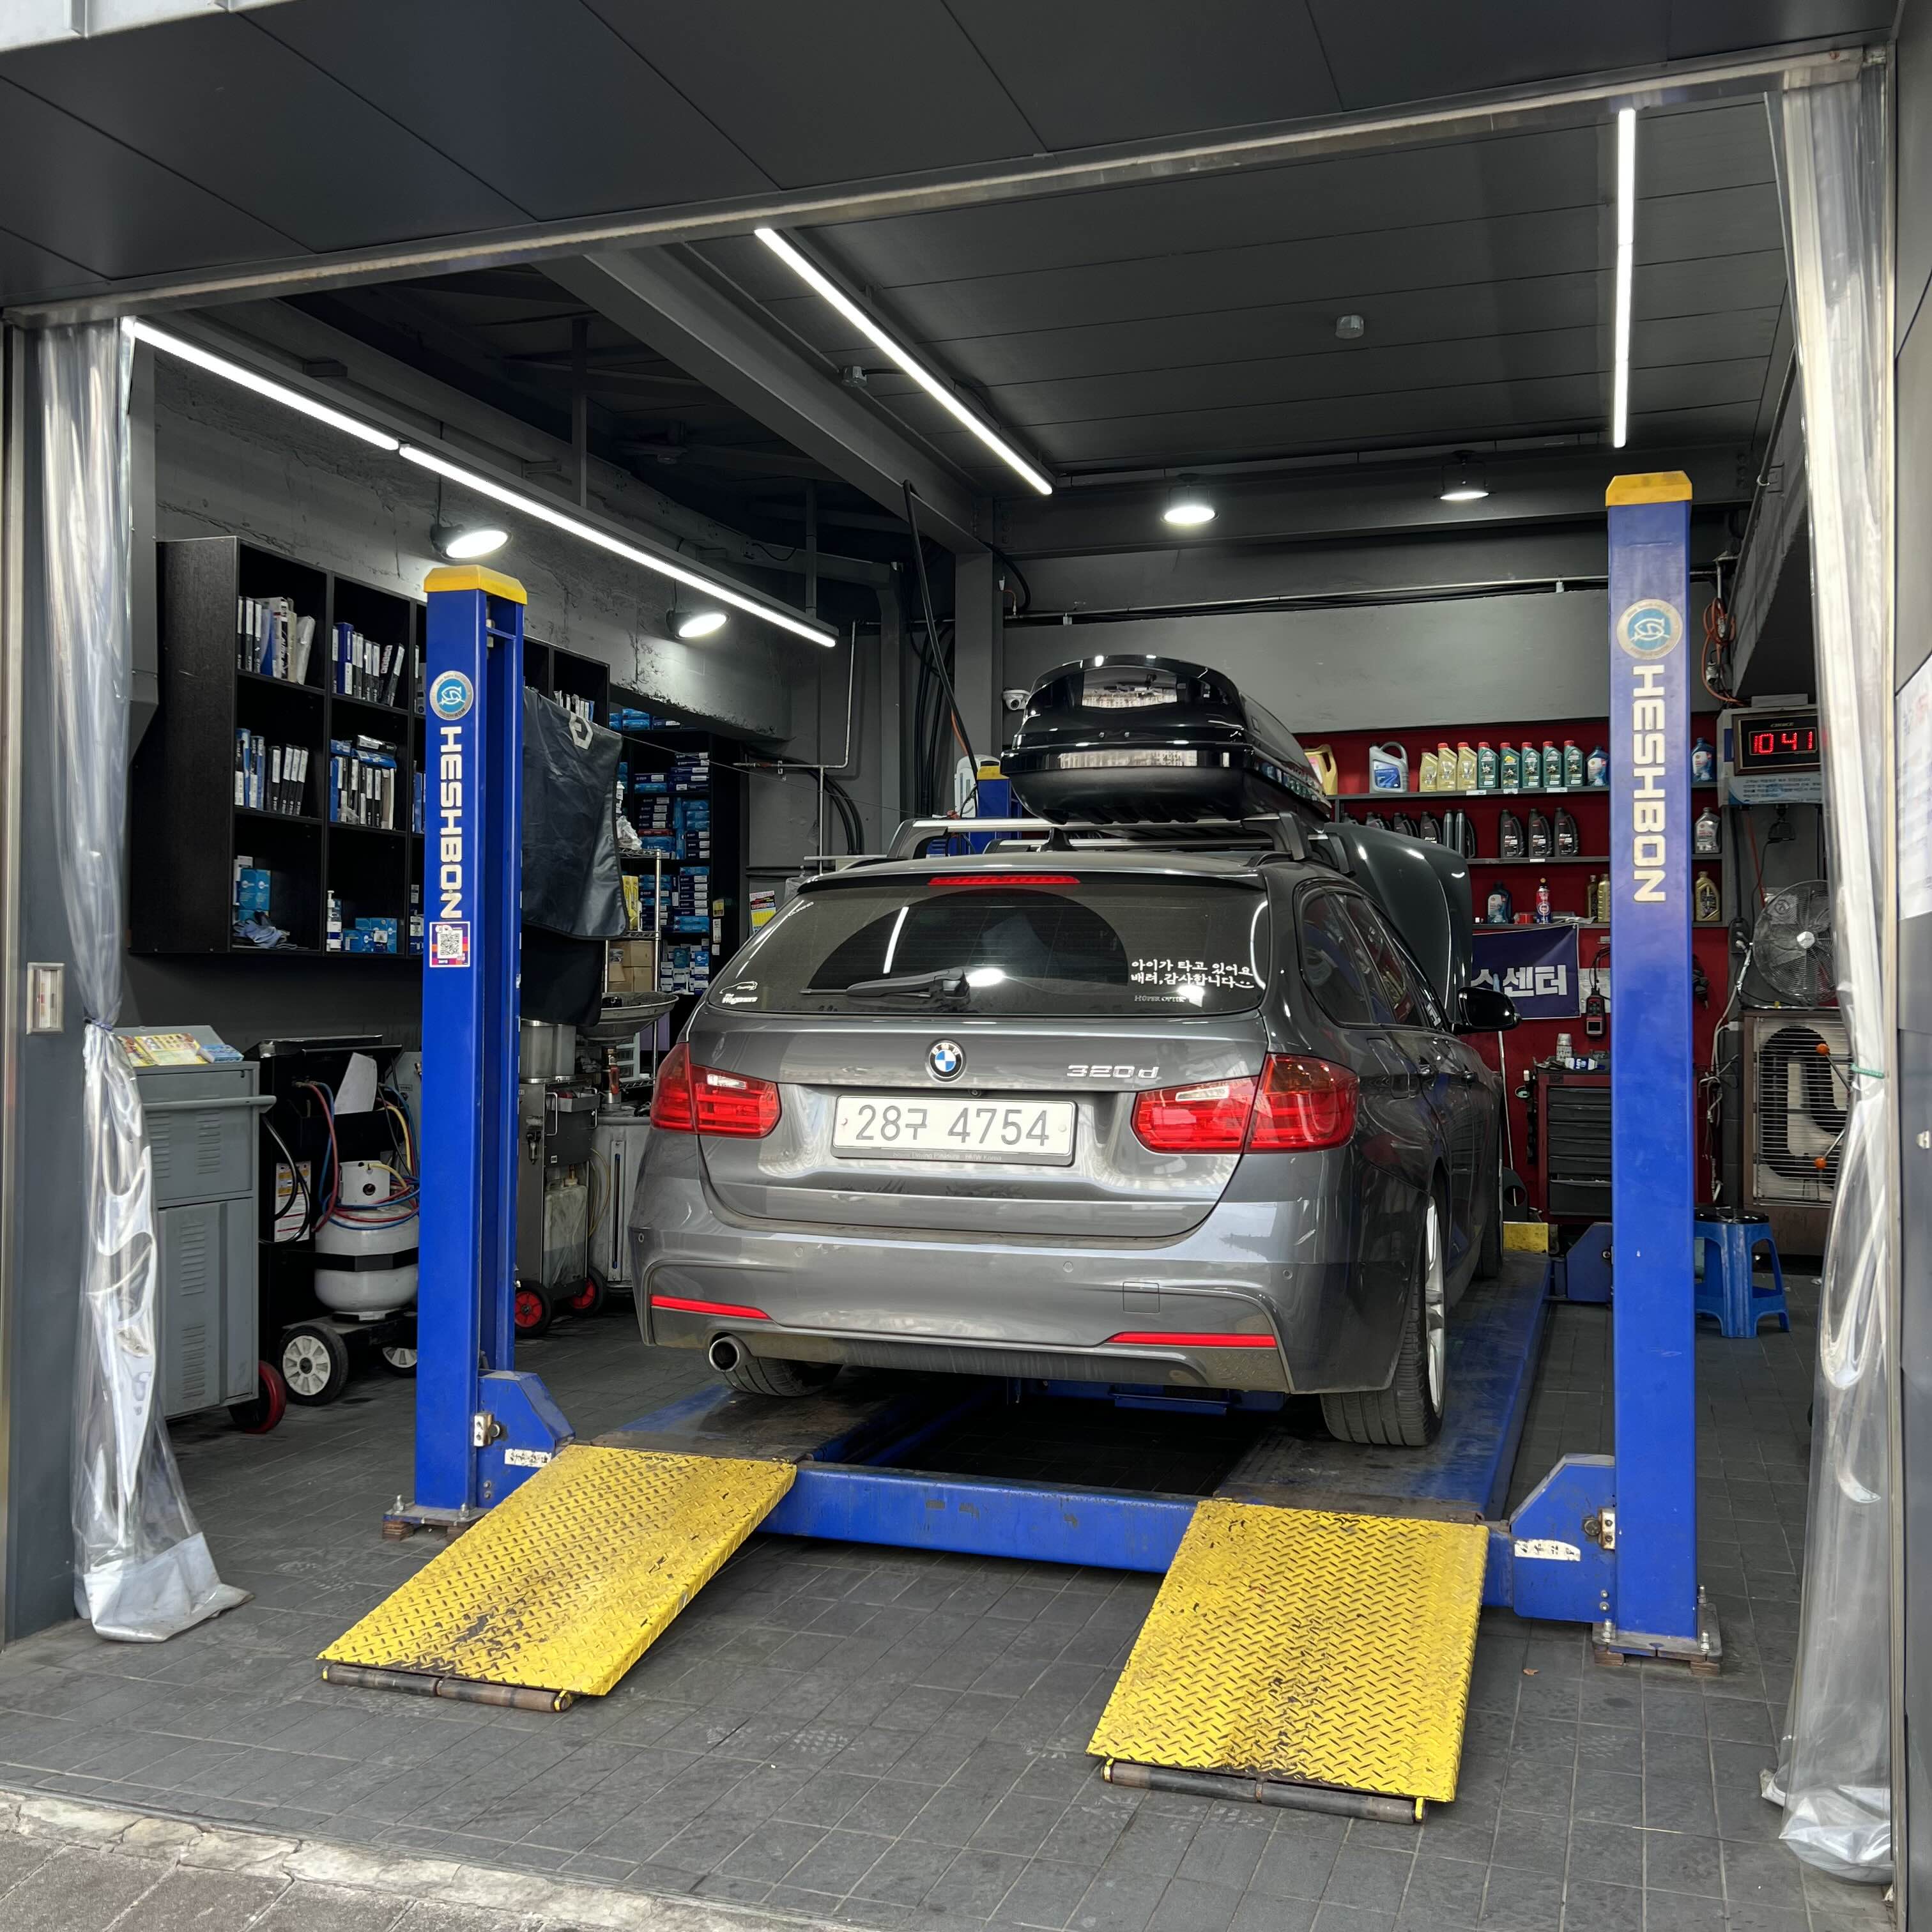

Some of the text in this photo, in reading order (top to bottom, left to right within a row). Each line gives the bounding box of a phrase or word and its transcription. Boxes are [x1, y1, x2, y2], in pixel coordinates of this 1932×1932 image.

[1633, 664, 1666, 901] HESHBON
[440, 726, 463, 919] HESHBON
[1131, 959, 1254, 976] 아이가 타고 있어요
[1066, 1064, 1160, 1078] 320d
[856, 1104, 1050, 1147] 28구 4754
